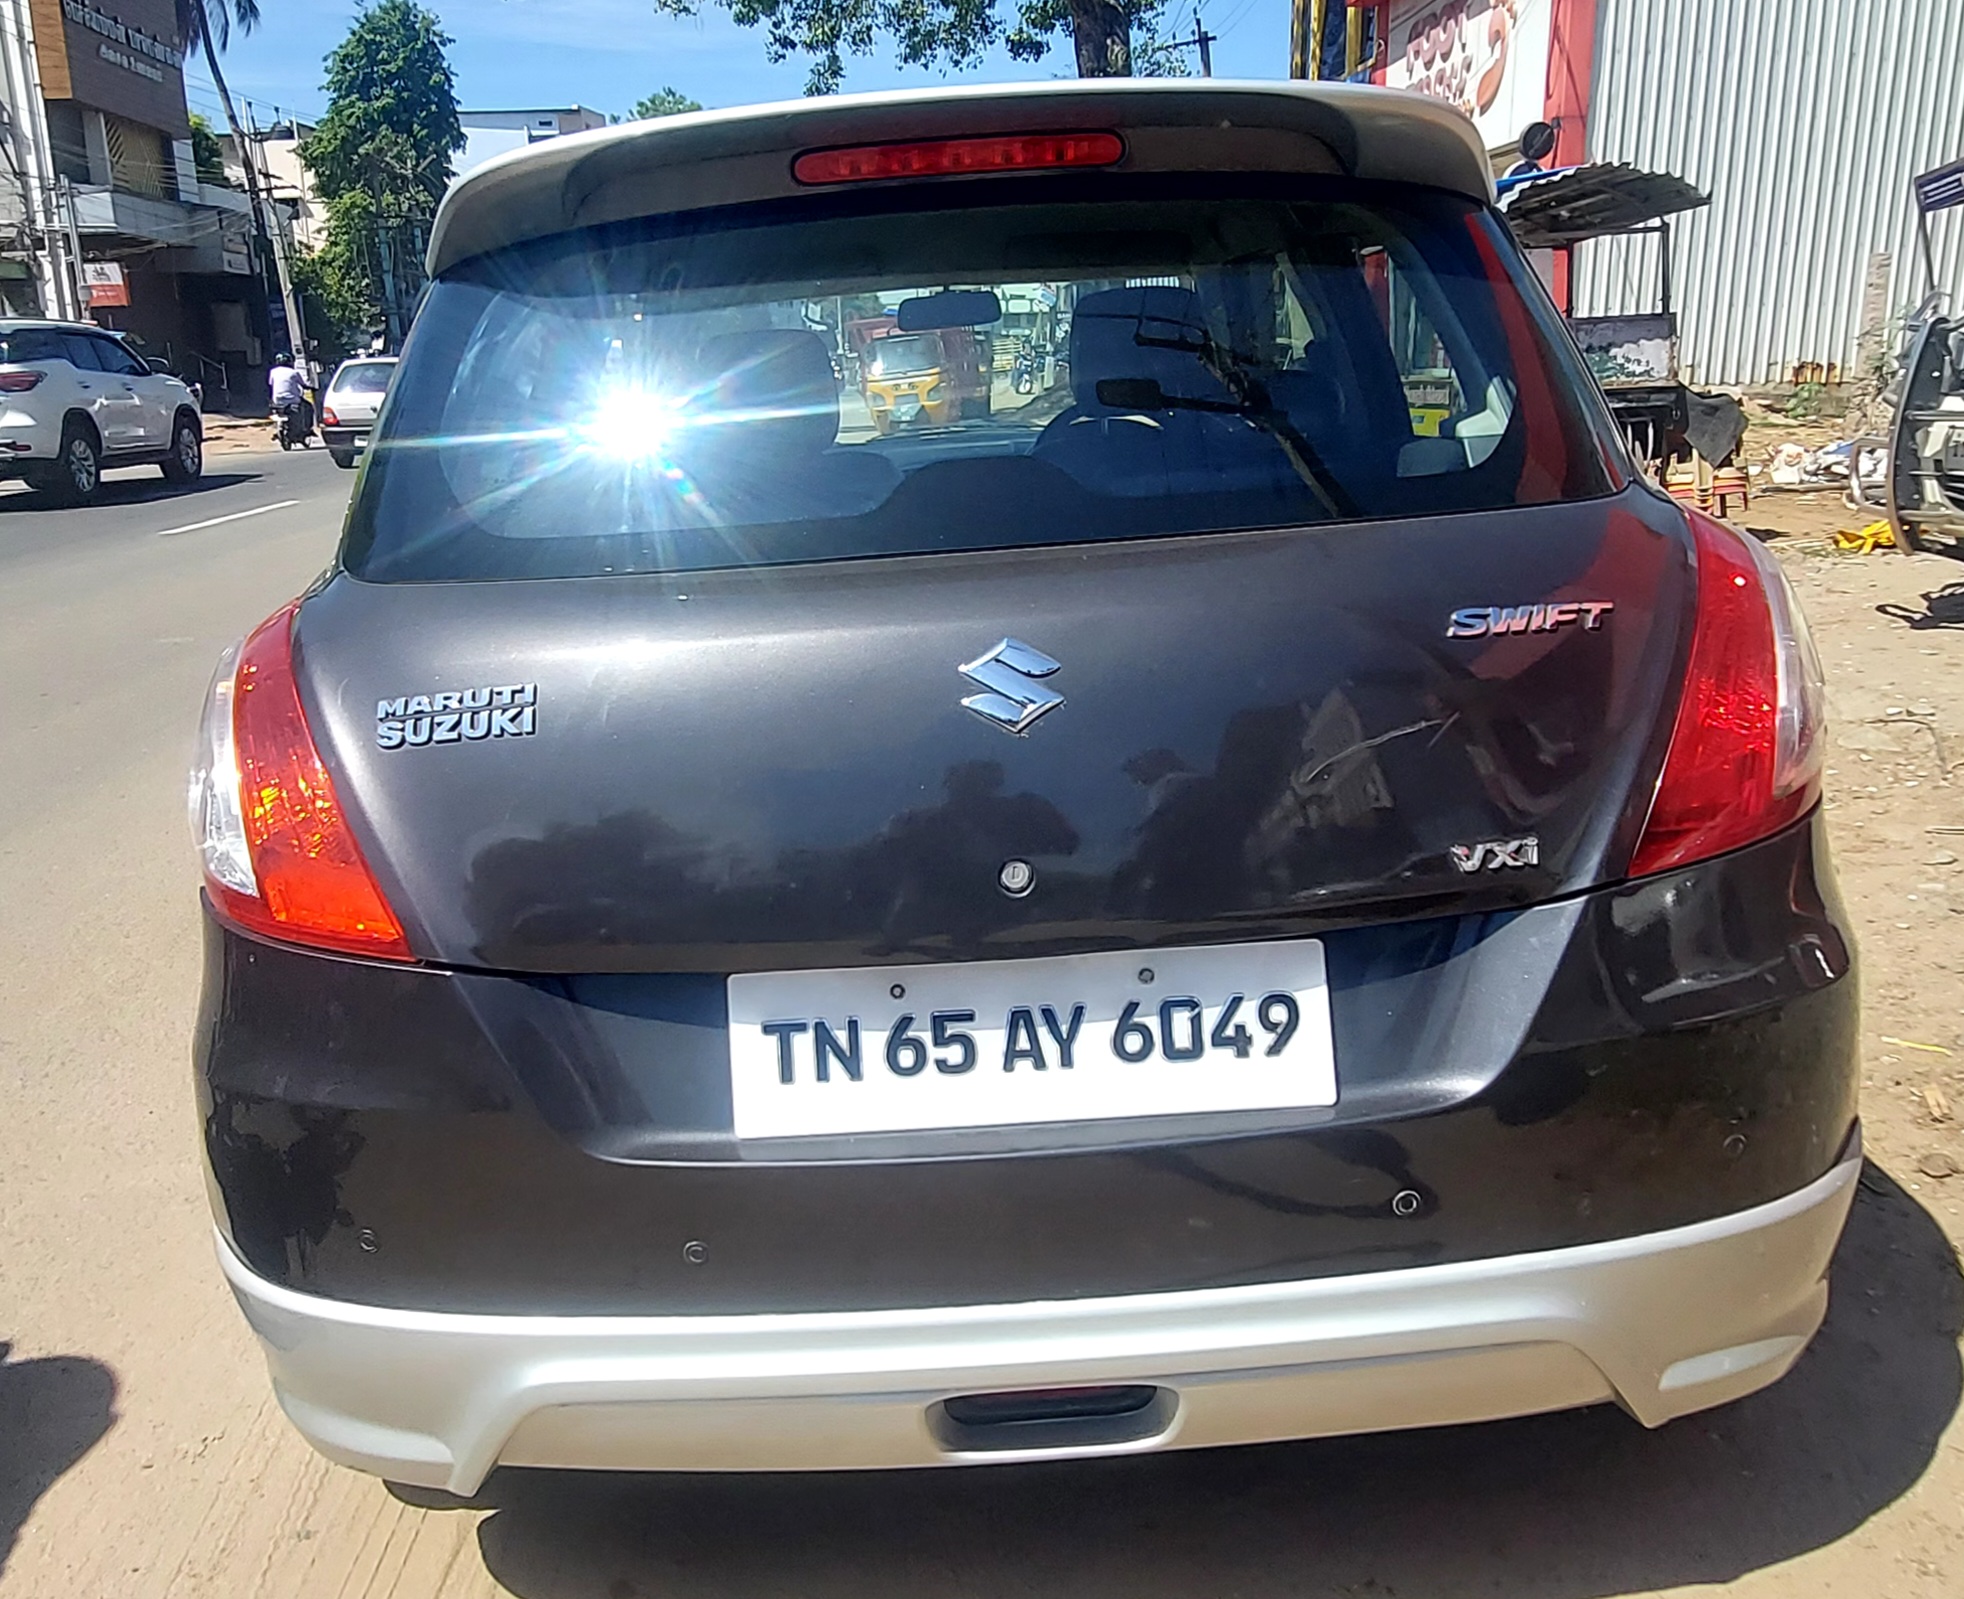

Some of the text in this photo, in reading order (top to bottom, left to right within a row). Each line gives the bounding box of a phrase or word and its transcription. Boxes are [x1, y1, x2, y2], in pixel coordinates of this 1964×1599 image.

[1446, 602, 1614, 640] SWIFT
[377, 682, 538, 721] MARUTI
[376, 706, 538, 749] SUZUKI
[761, 990, 1300, 1084] TN 65 AY 6049
